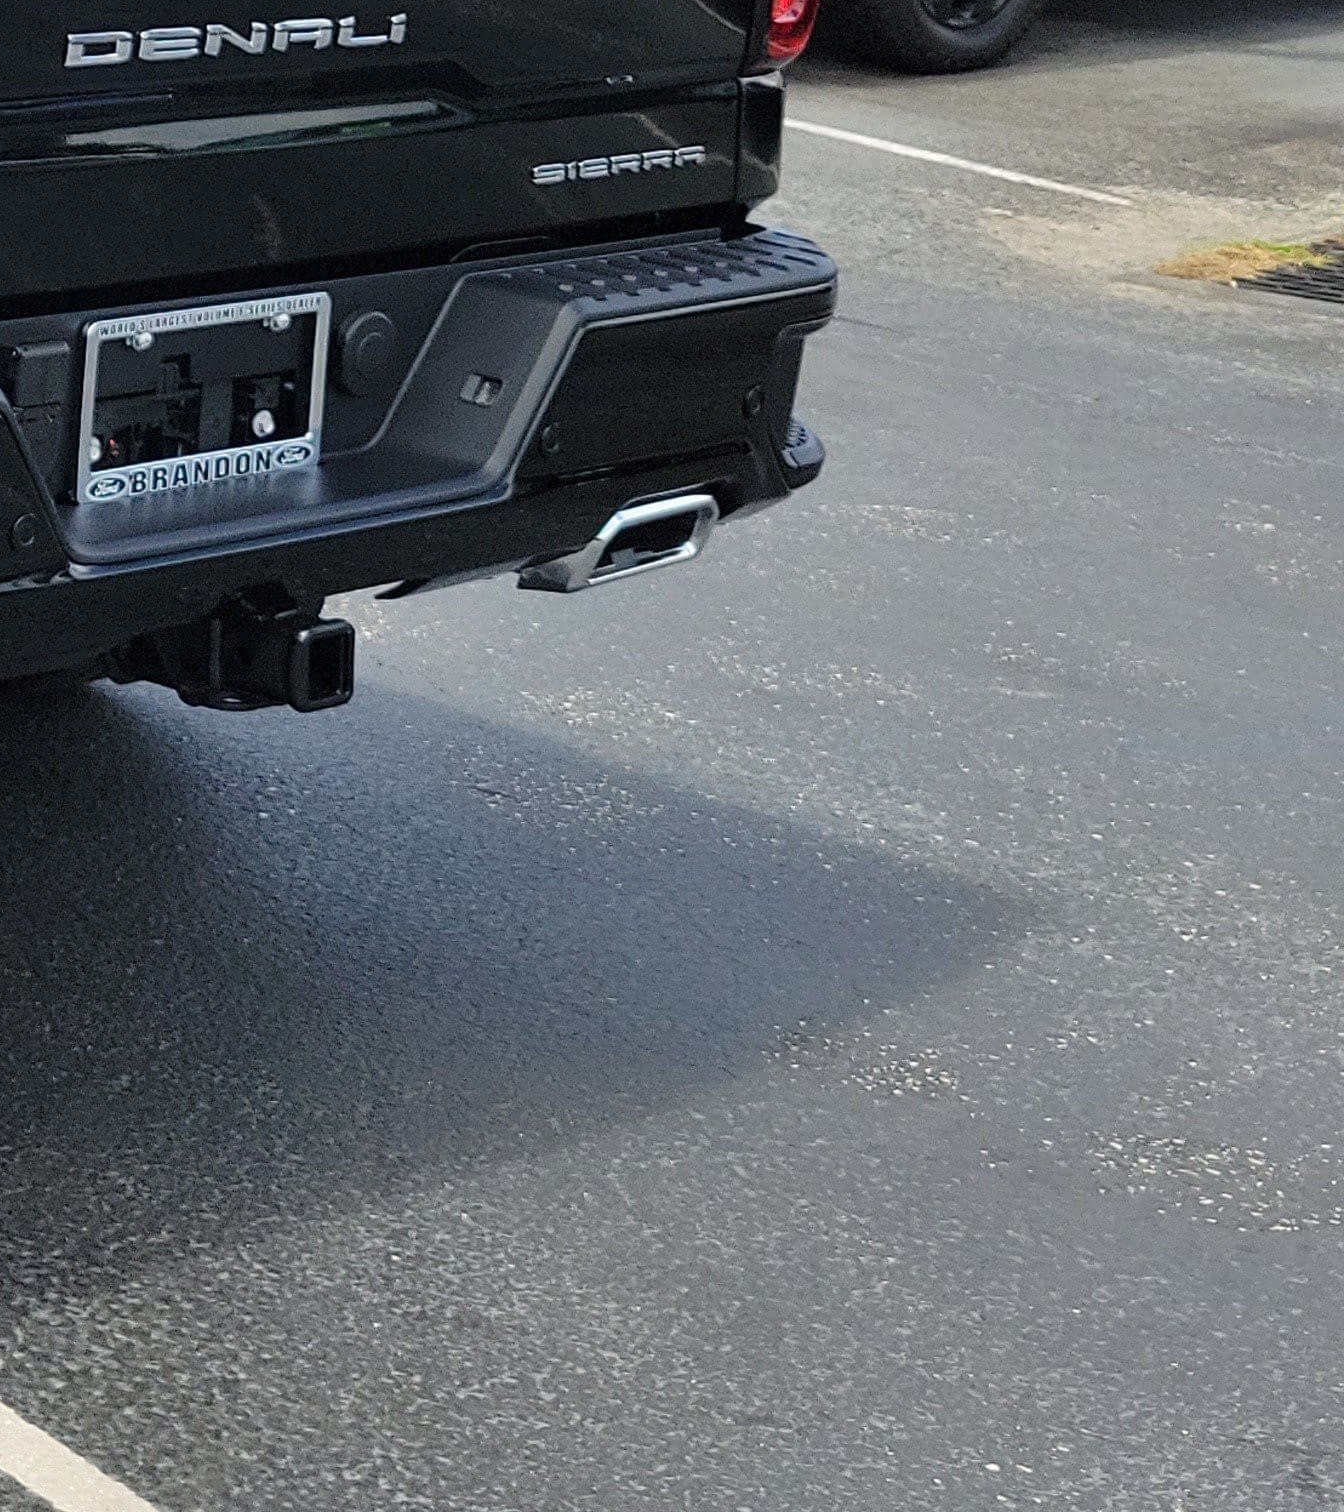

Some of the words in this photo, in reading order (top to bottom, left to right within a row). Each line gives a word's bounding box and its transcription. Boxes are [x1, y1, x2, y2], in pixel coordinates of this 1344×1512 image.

[64, 13, 407, 67] DENALI
[531, 145, 705, 185] SIERRA
[130, 448, 273, 494] BRANDON
